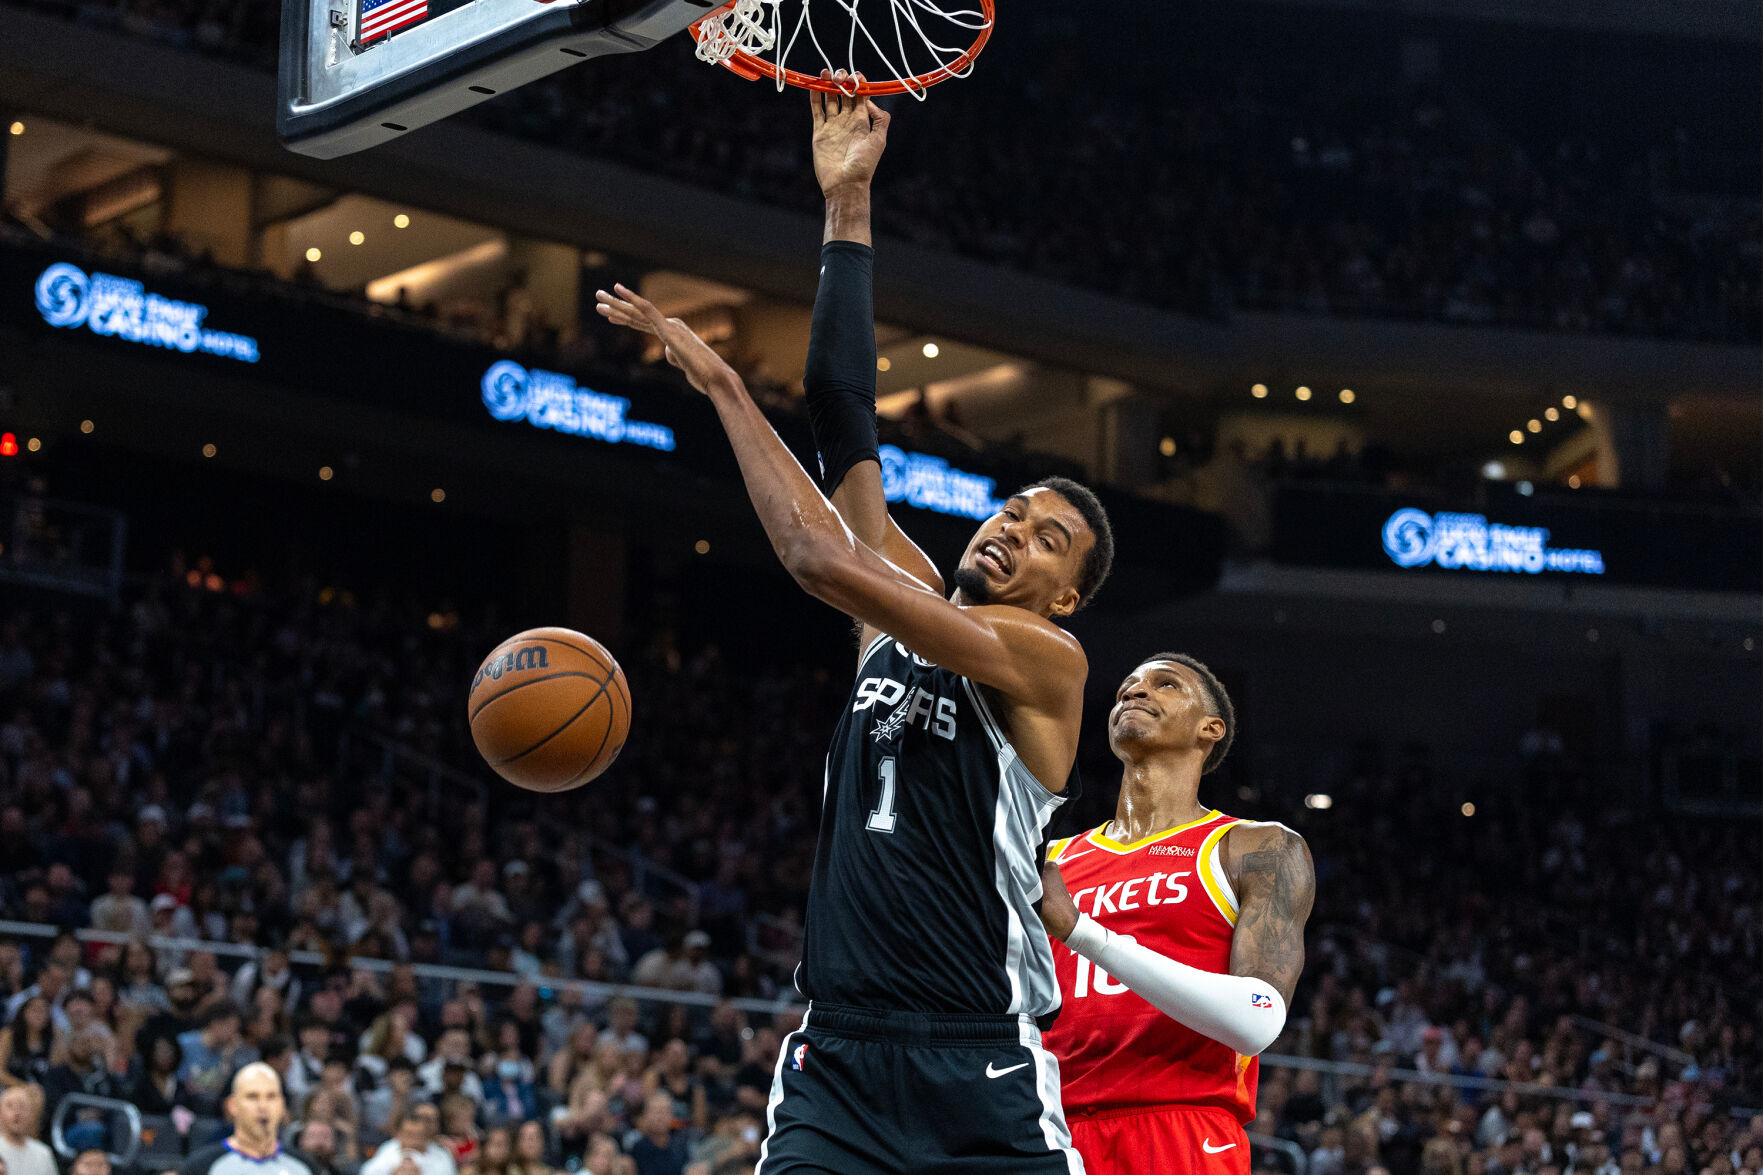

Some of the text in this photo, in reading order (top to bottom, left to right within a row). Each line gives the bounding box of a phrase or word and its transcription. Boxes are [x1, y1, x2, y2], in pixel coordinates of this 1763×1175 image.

[87, 299, 200, 353] CASINO
[1434, 536, 1545, 574] CASINO
[865, 755, 897, 834] 1
[1150, 845, 1195, 854] MEMORIAL
